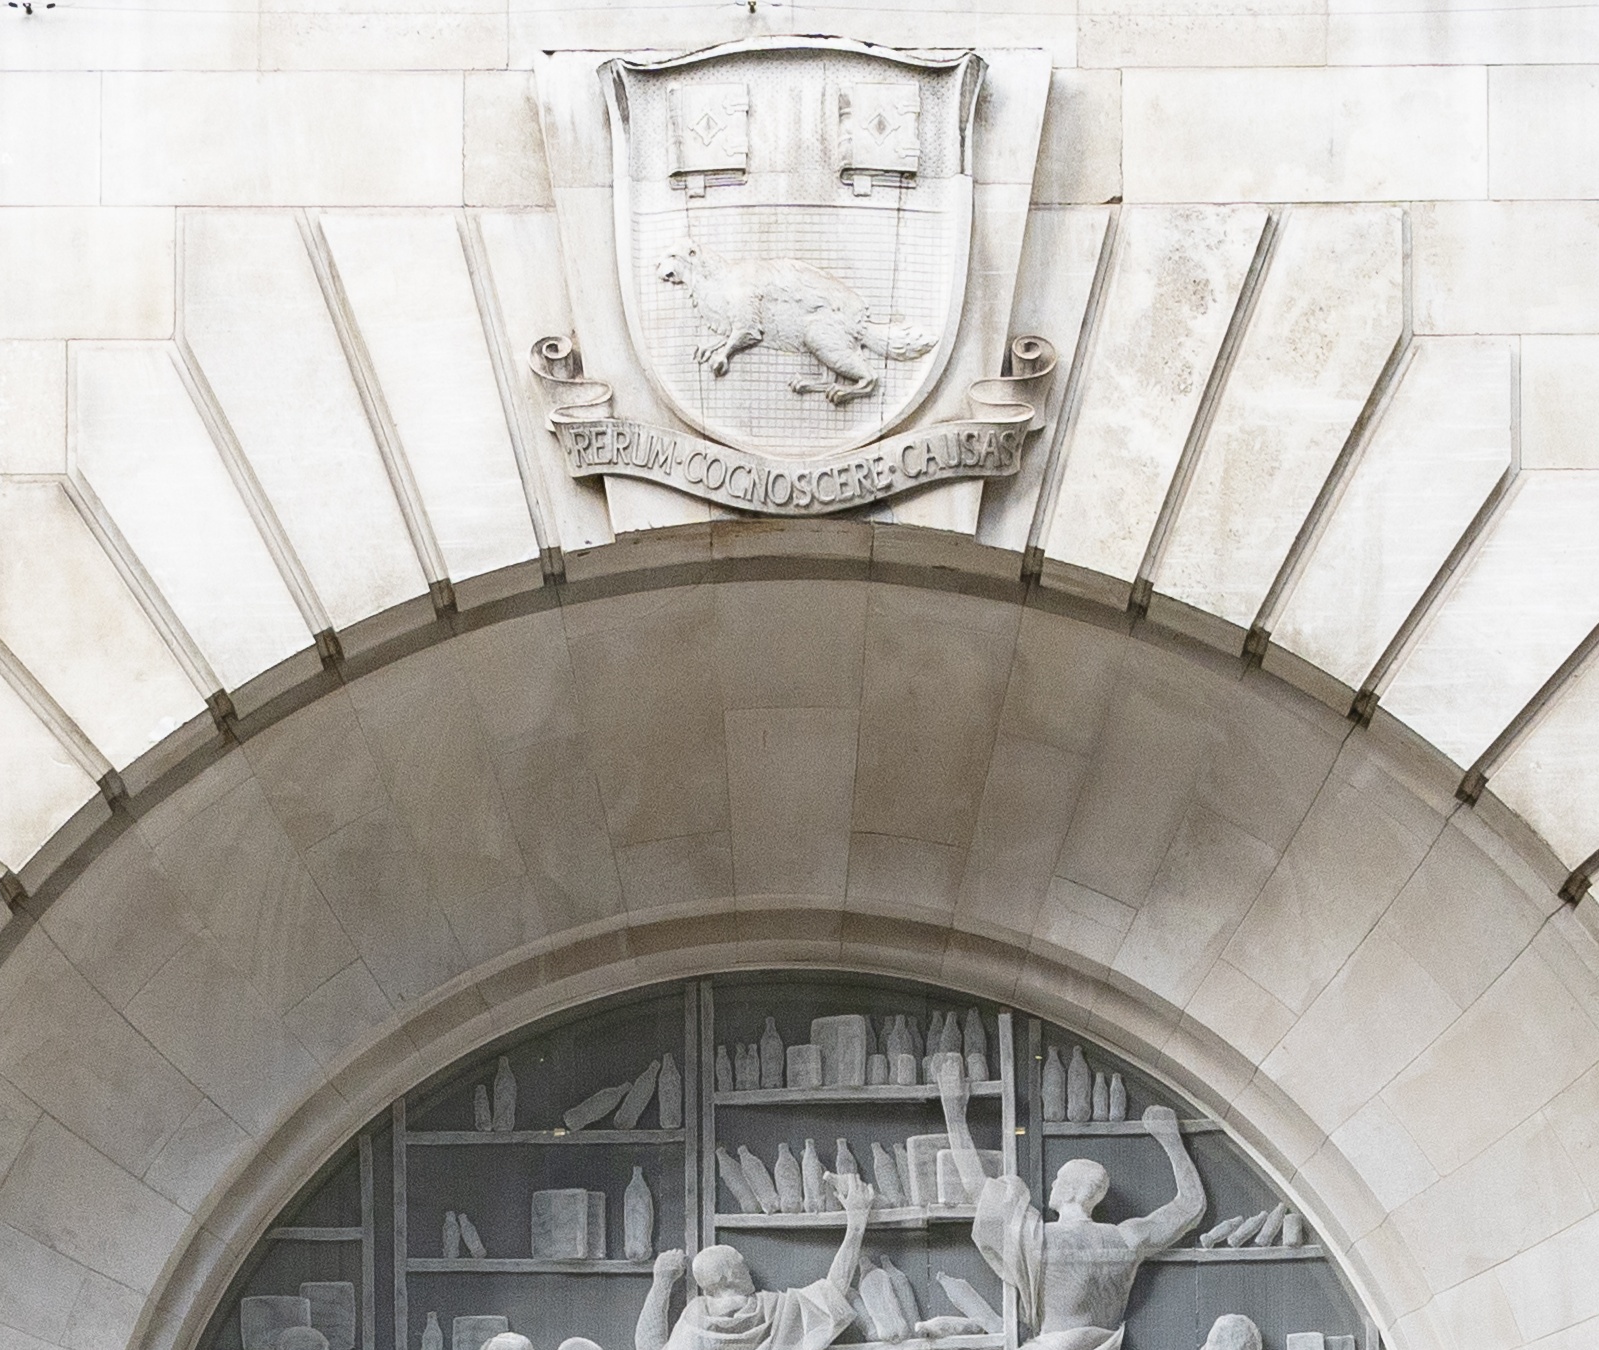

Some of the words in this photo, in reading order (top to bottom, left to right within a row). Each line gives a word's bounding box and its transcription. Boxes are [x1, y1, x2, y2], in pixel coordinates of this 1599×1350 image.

[570, 427, 678, 476] RERUM
[683, 451, 893, 508] COGNOSCERE
[900, 428, 1017, 479] CAUSAS
